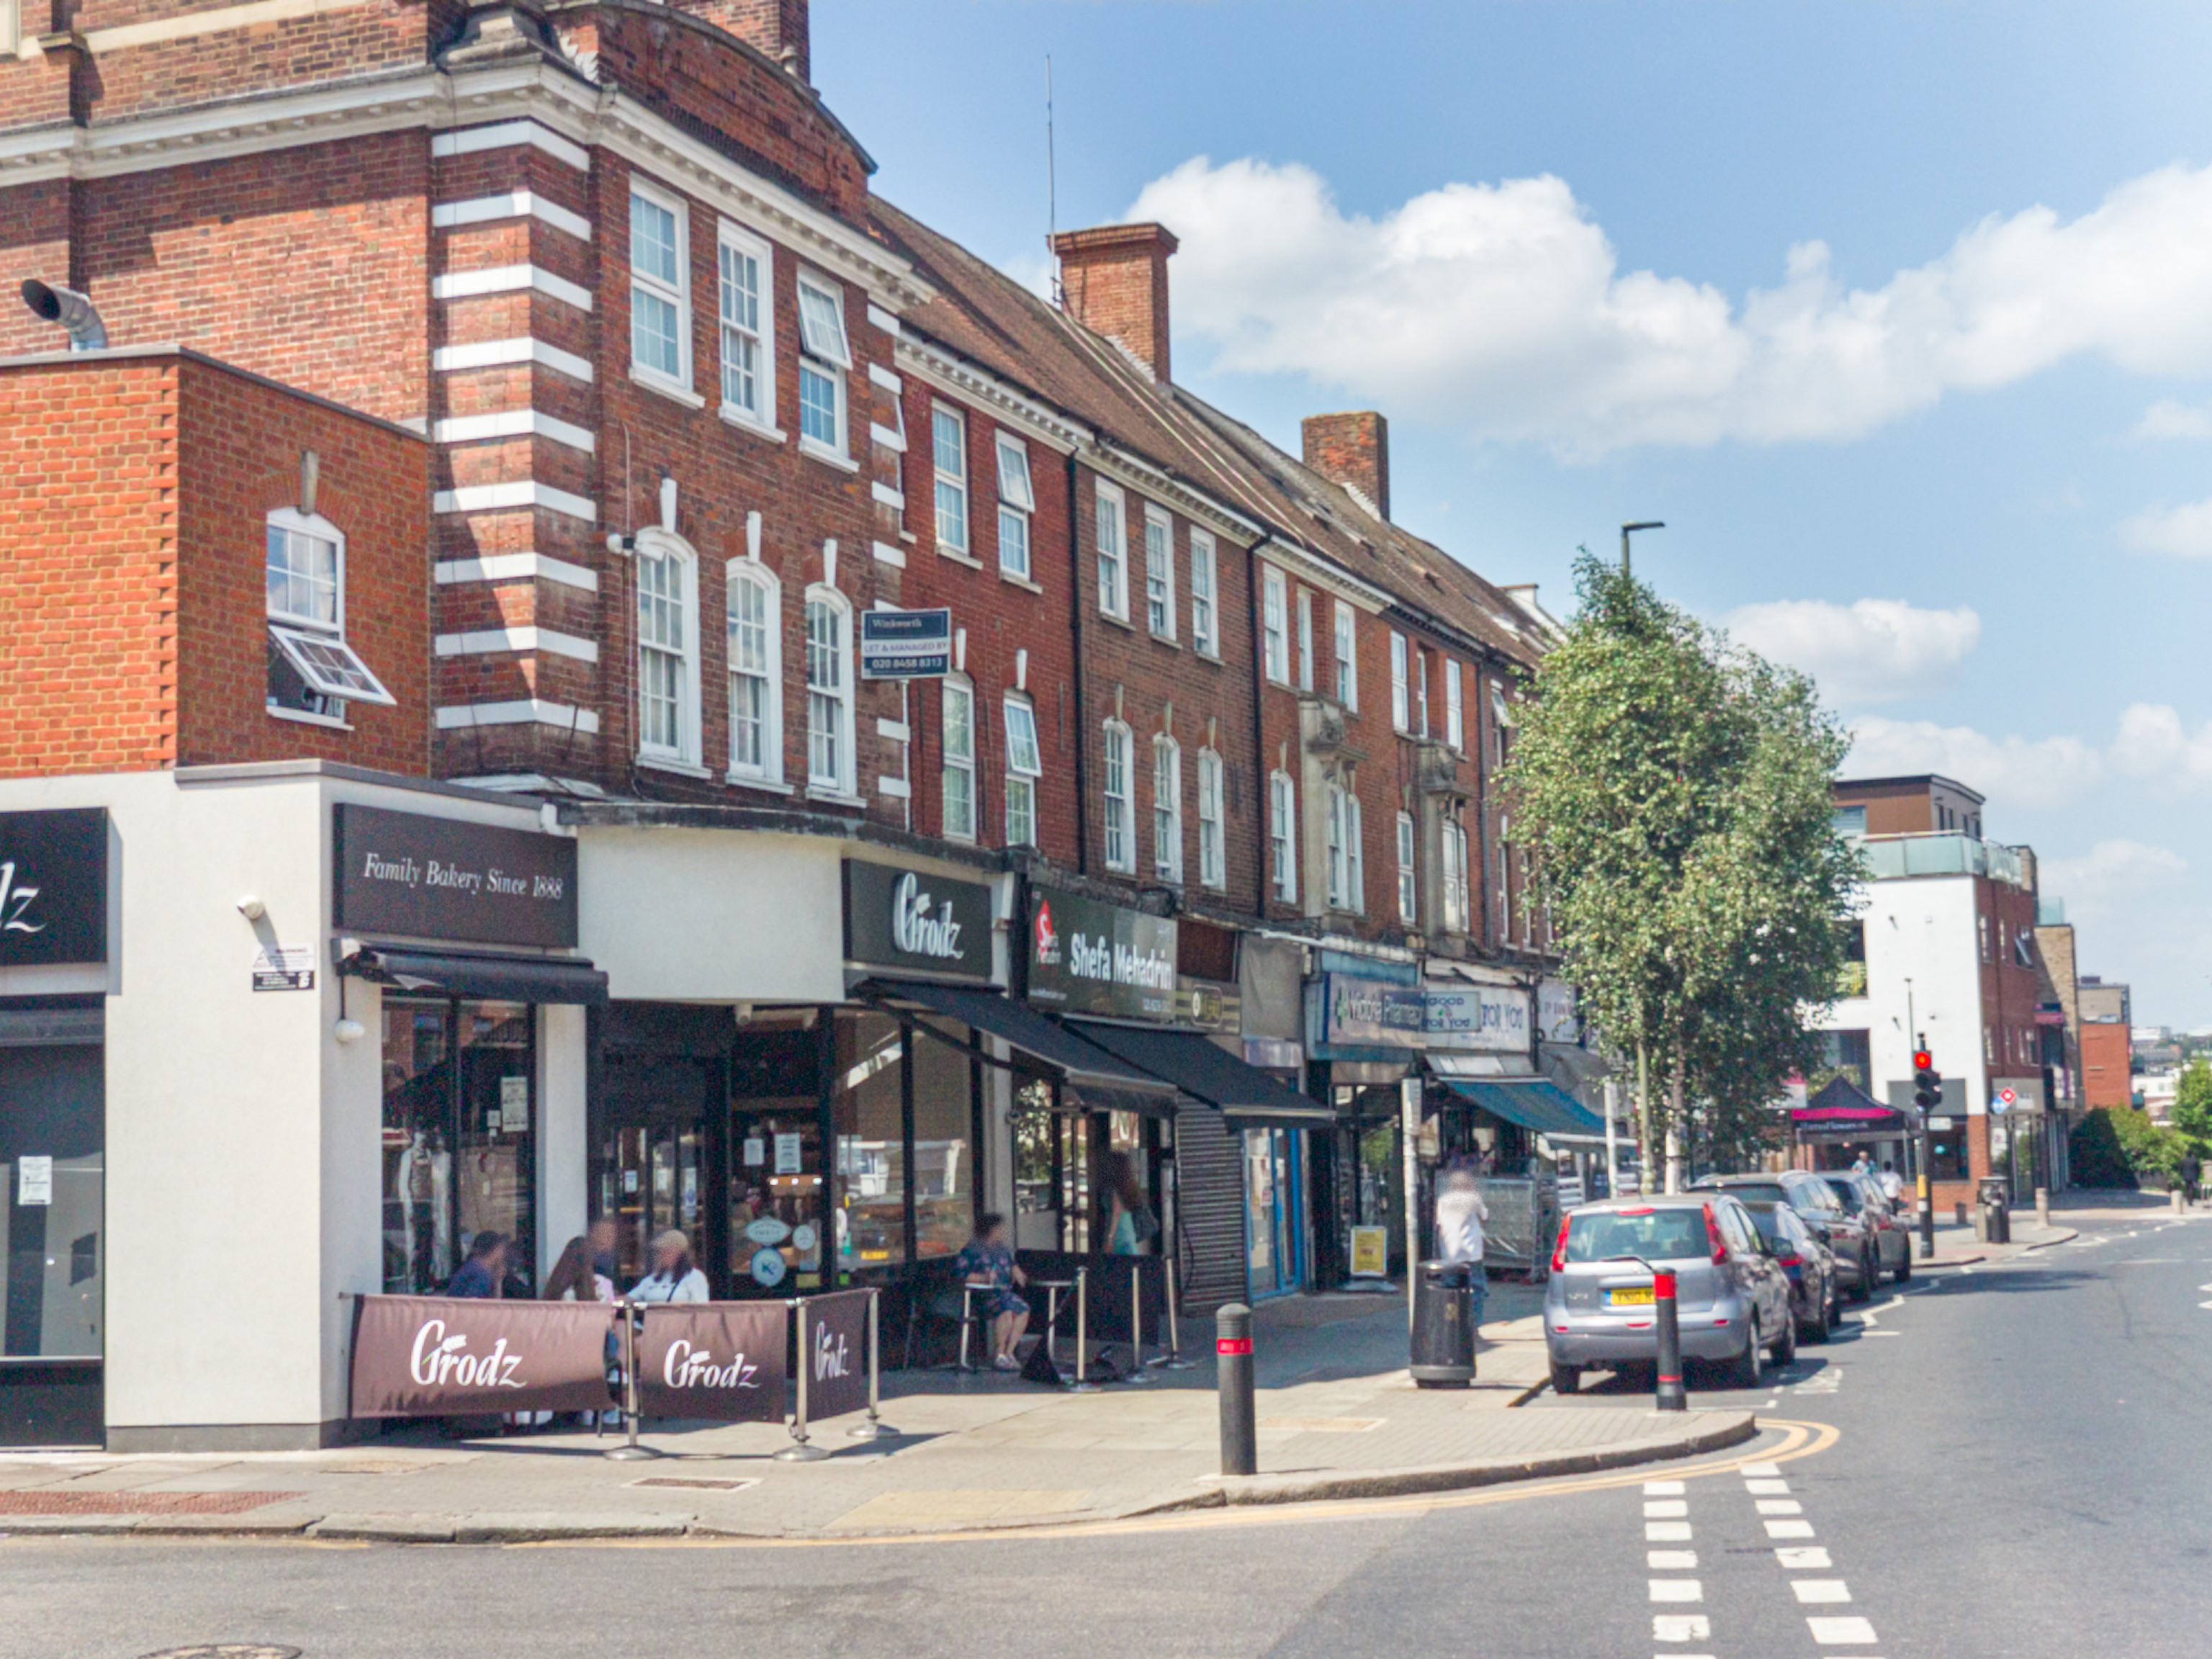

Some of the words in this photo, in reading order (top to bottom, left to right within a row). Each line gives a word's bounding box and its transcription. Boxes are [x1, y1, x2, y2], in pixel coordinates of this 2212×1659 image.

[364, 853, 420, 888] Family
[426, 860, 482, 895] Bakery
[487, 868, 526, 895] Since
[532, 876, 564, 899] 1888
[894, 873, 964, 959] Grodz
[1070, 932, 1112, 981] Shefa
[1114, 943, 1172, 991] Mehadrin
[1428, 997, 1465, 1006] GOOD
[410, 1320, 526, 1388] Grodz
[665, 1340, 760, 1388] Grodz
[815, 1321, 850, 1381] Grodz
